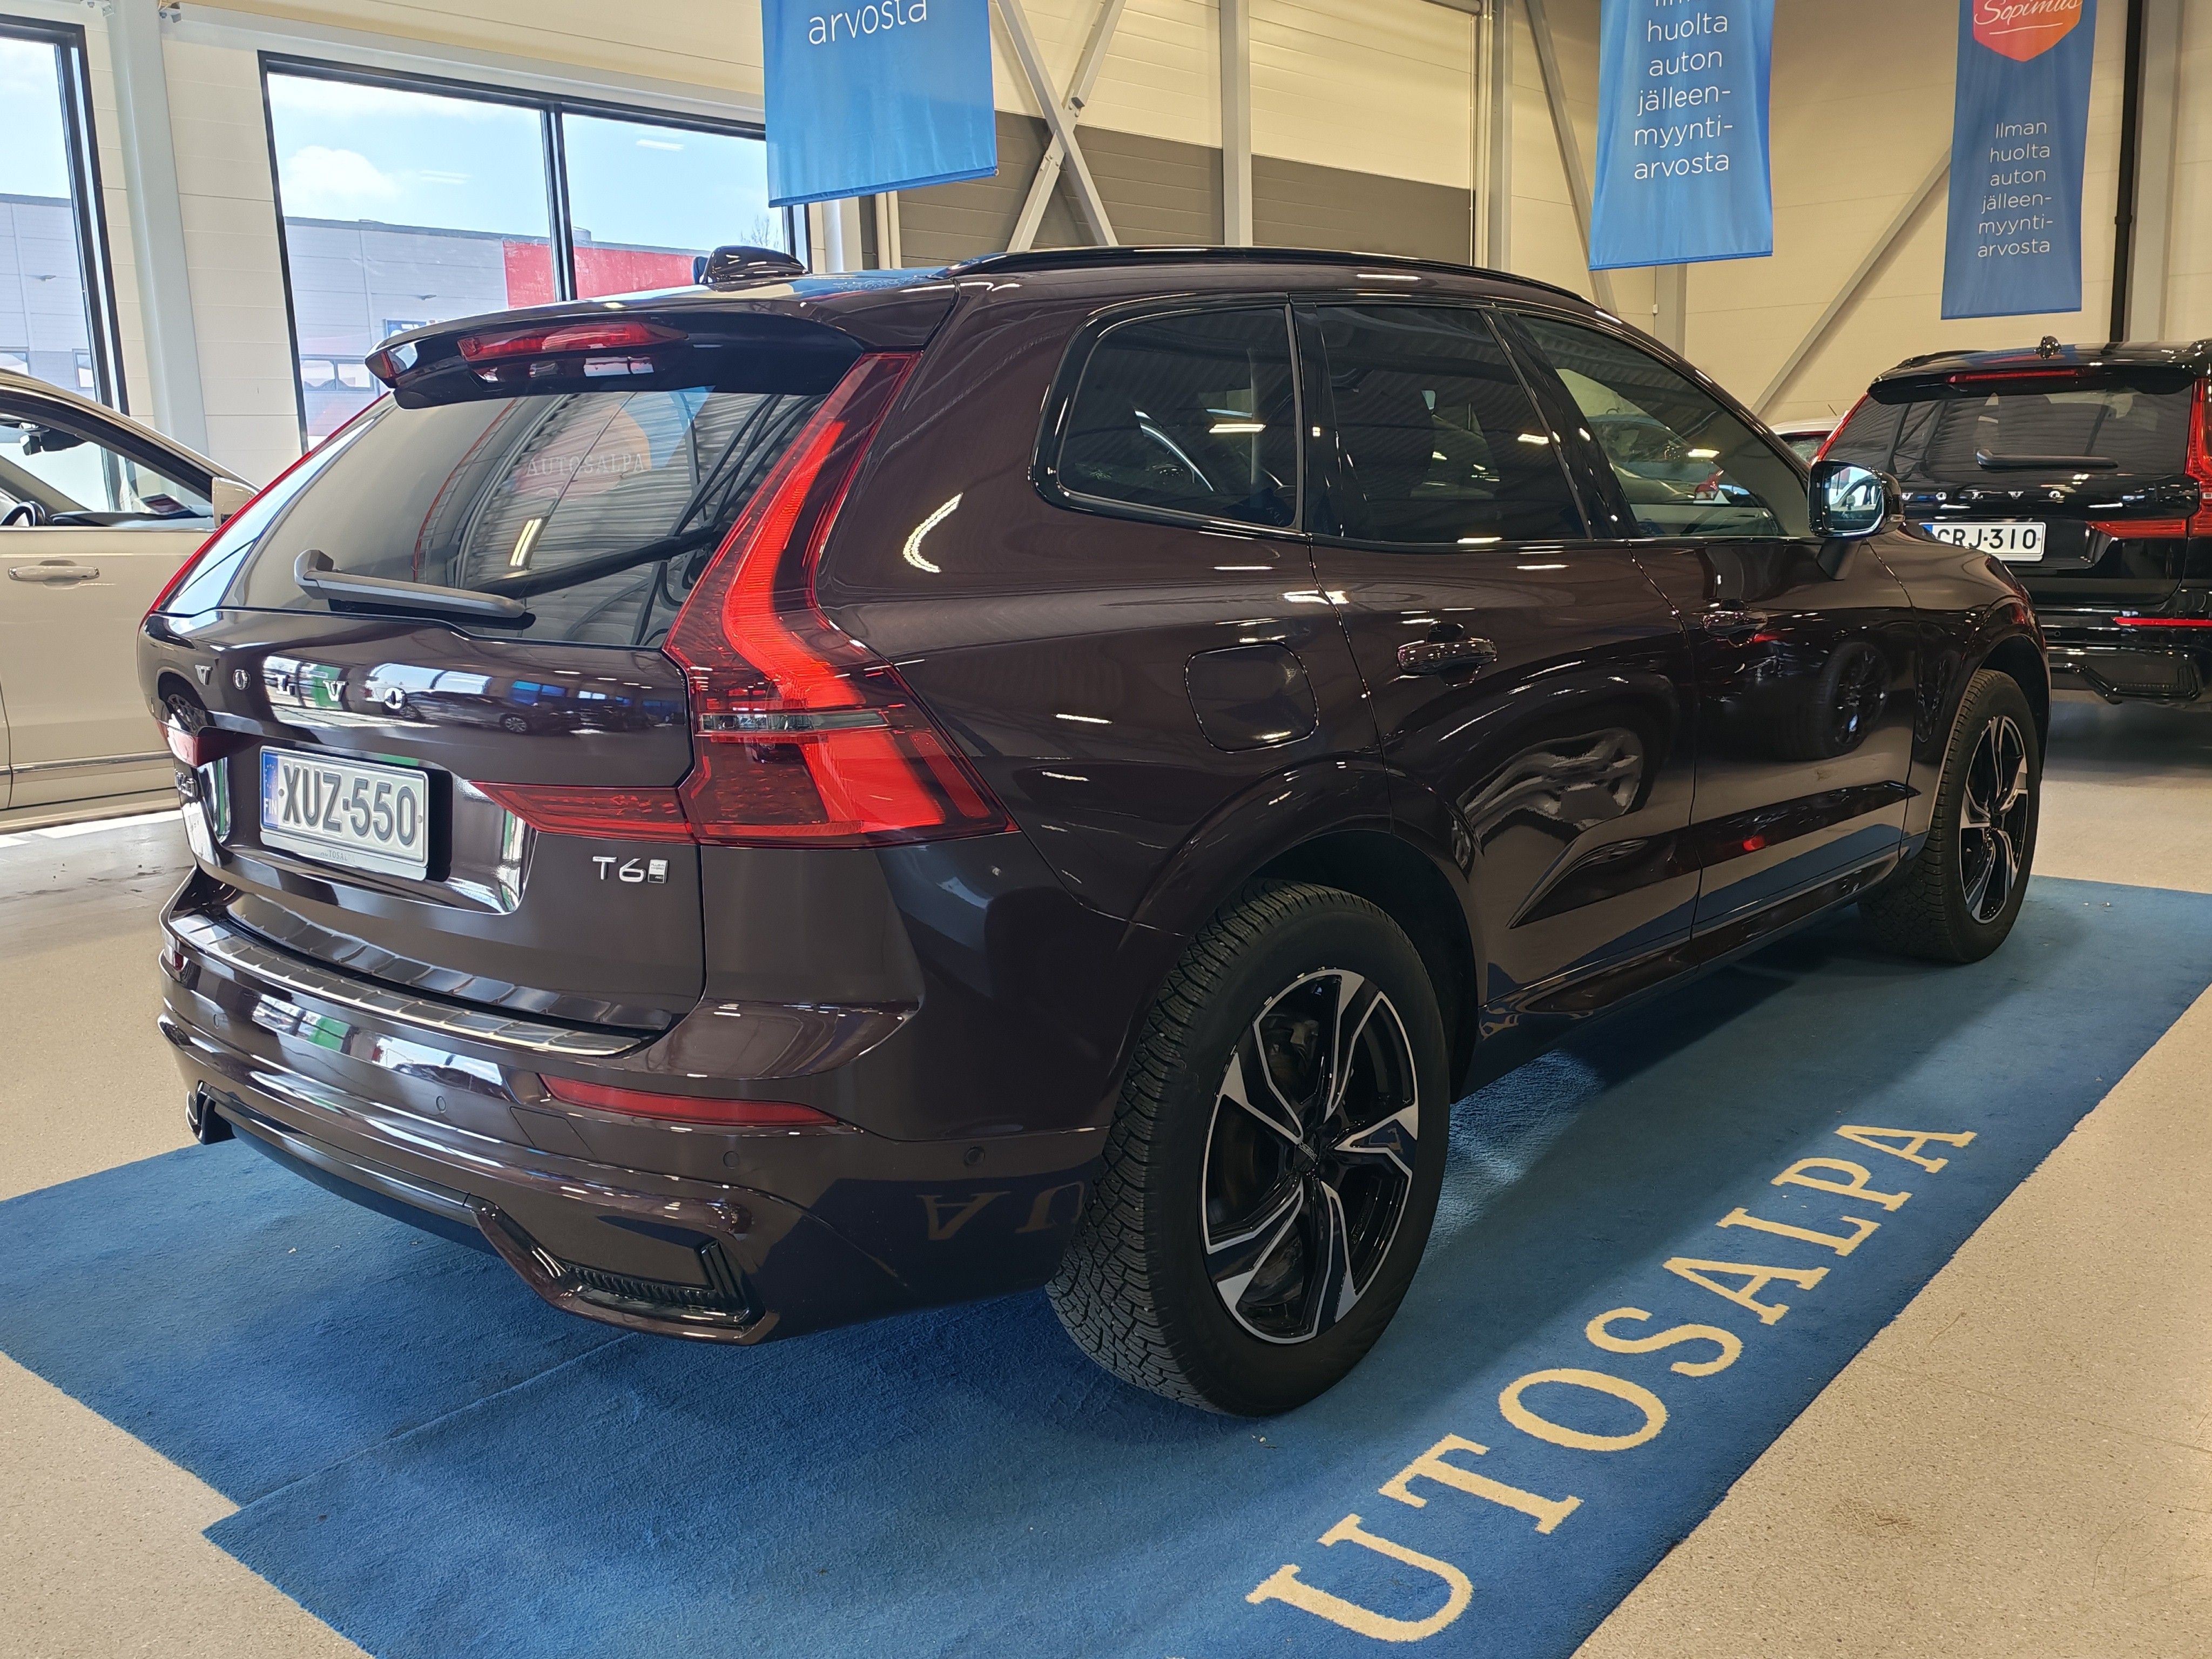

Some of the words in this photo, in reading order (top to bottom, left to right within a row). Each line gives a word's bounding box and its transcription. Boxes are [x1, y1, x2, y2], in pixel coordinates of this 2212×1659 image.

[808, 0, 927, 45] arvosta
[1647, 12, 1728, 42] huolta
[1649, 50, 1722, 77] auton
[1637, 85, 1730, 117] jälleen-
[1634, 114, 1732, 148] myynti-
[1995, 122, 2047, 139] Ilman
[1634, 151, 1729, 180] arvosta
[1990, 143, 2051, 163] huolta
[1990, 167, 2046, 187] auton
[1981, 191, 2052, 214] jälleen-
[1979, 214, 2053, 236] myynti-
[1977, 238, 2051, 258] arvosta
[527, 453, 645, 476] AUTOSALPA
[195, 664, 408, 710] VOLVO
[264, 798, 278, 816] FIN
[282, 763, 418, 846] XUZ-550
[592, 856, 646, 883] T6
[1245, 1125, 1977, 1642] UTOSALPA
